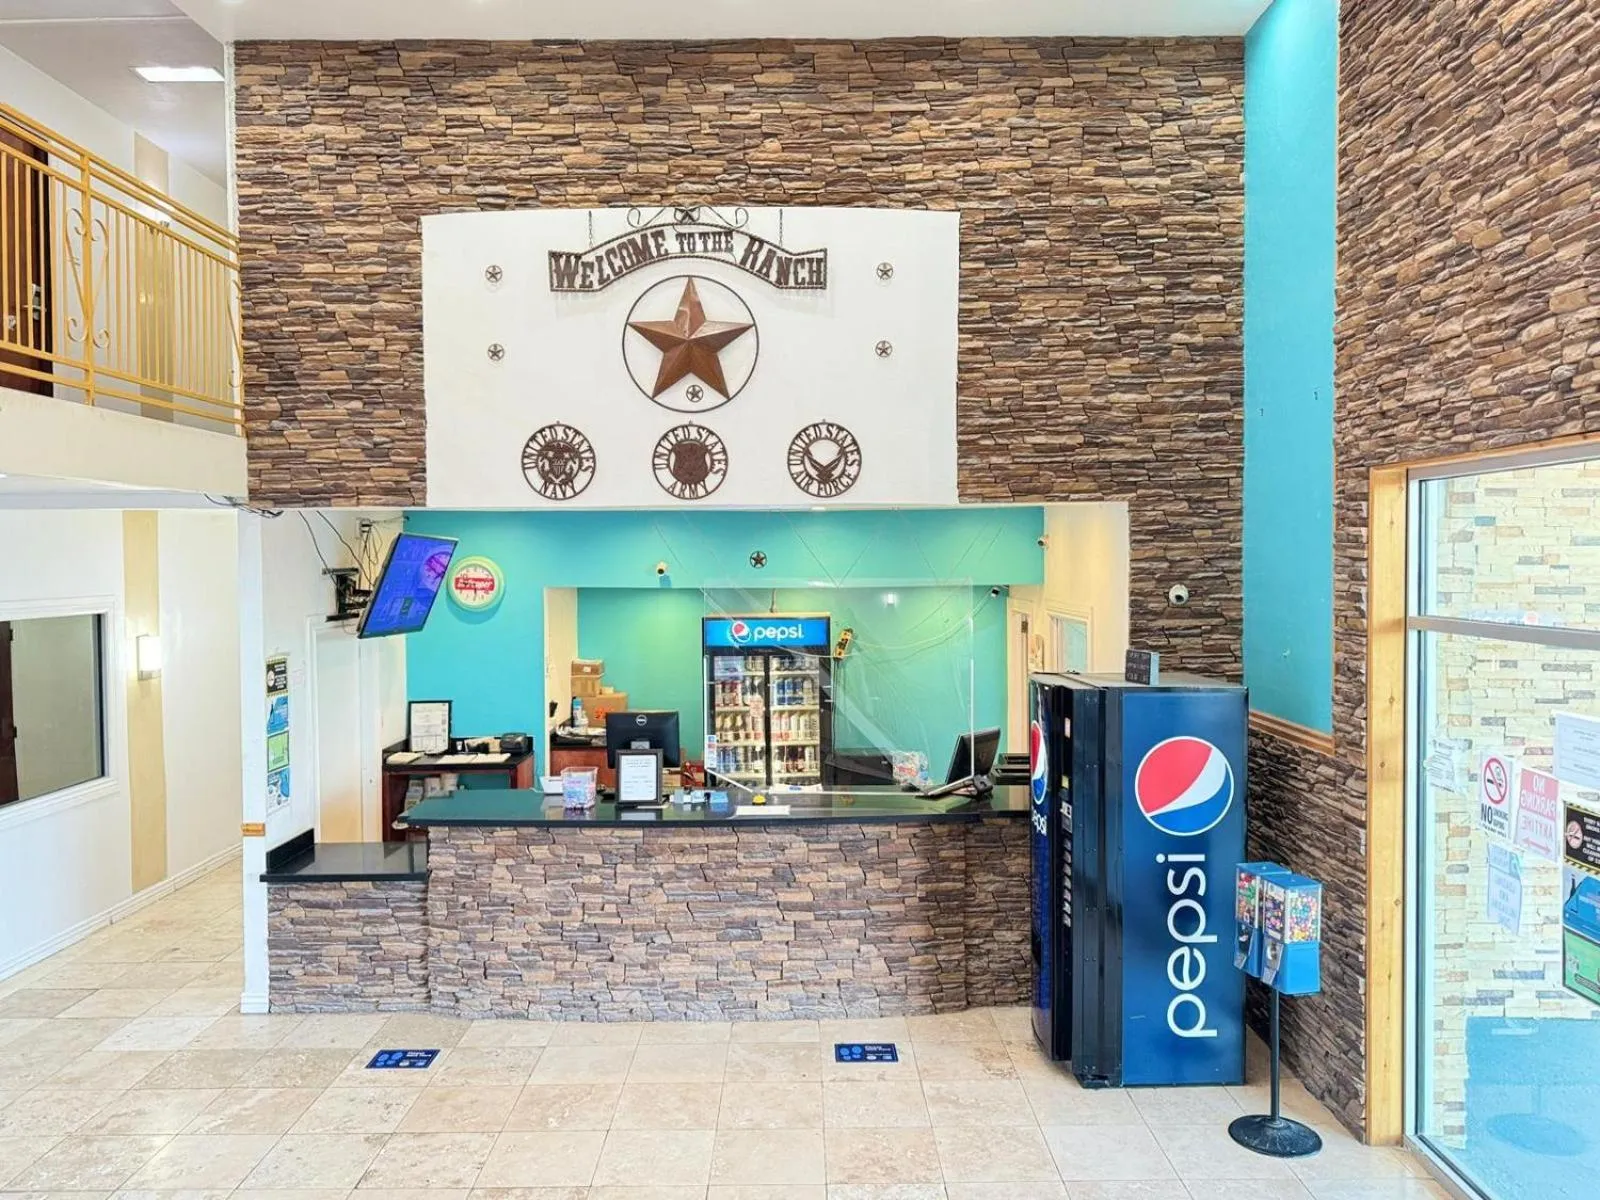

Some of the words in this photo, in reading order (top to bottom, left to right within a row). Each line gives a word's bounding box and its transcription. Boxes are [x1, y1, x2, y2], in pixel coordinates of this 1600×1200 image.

[550, 230, 669, 289] WELCOME
[676, 233, 696, 253] TO
[697, 232, 734, 253] THE
[739, 236, 824, 287] RANCH
[522, 424, 558, 470] UNITED
[561, 424, 595, 473] STATES
[653, 424, 690, 470] UNITED
[695, 424, 728, 476] STATES
[788, 423, 821, 465] UNITED
[826, 423, 861, 467] STATES
[540, 480, 577, 499] NAVY
[667, 480, 709, 499] ARMY
[791, 470, 814, 492] AIR
[817, 469, 859, 497] FORCE
[754, 624, 803, 643] pepsi
[1481, 803, 1493, 824] NO
[1156, 852, 1218, 1038] pepsi
